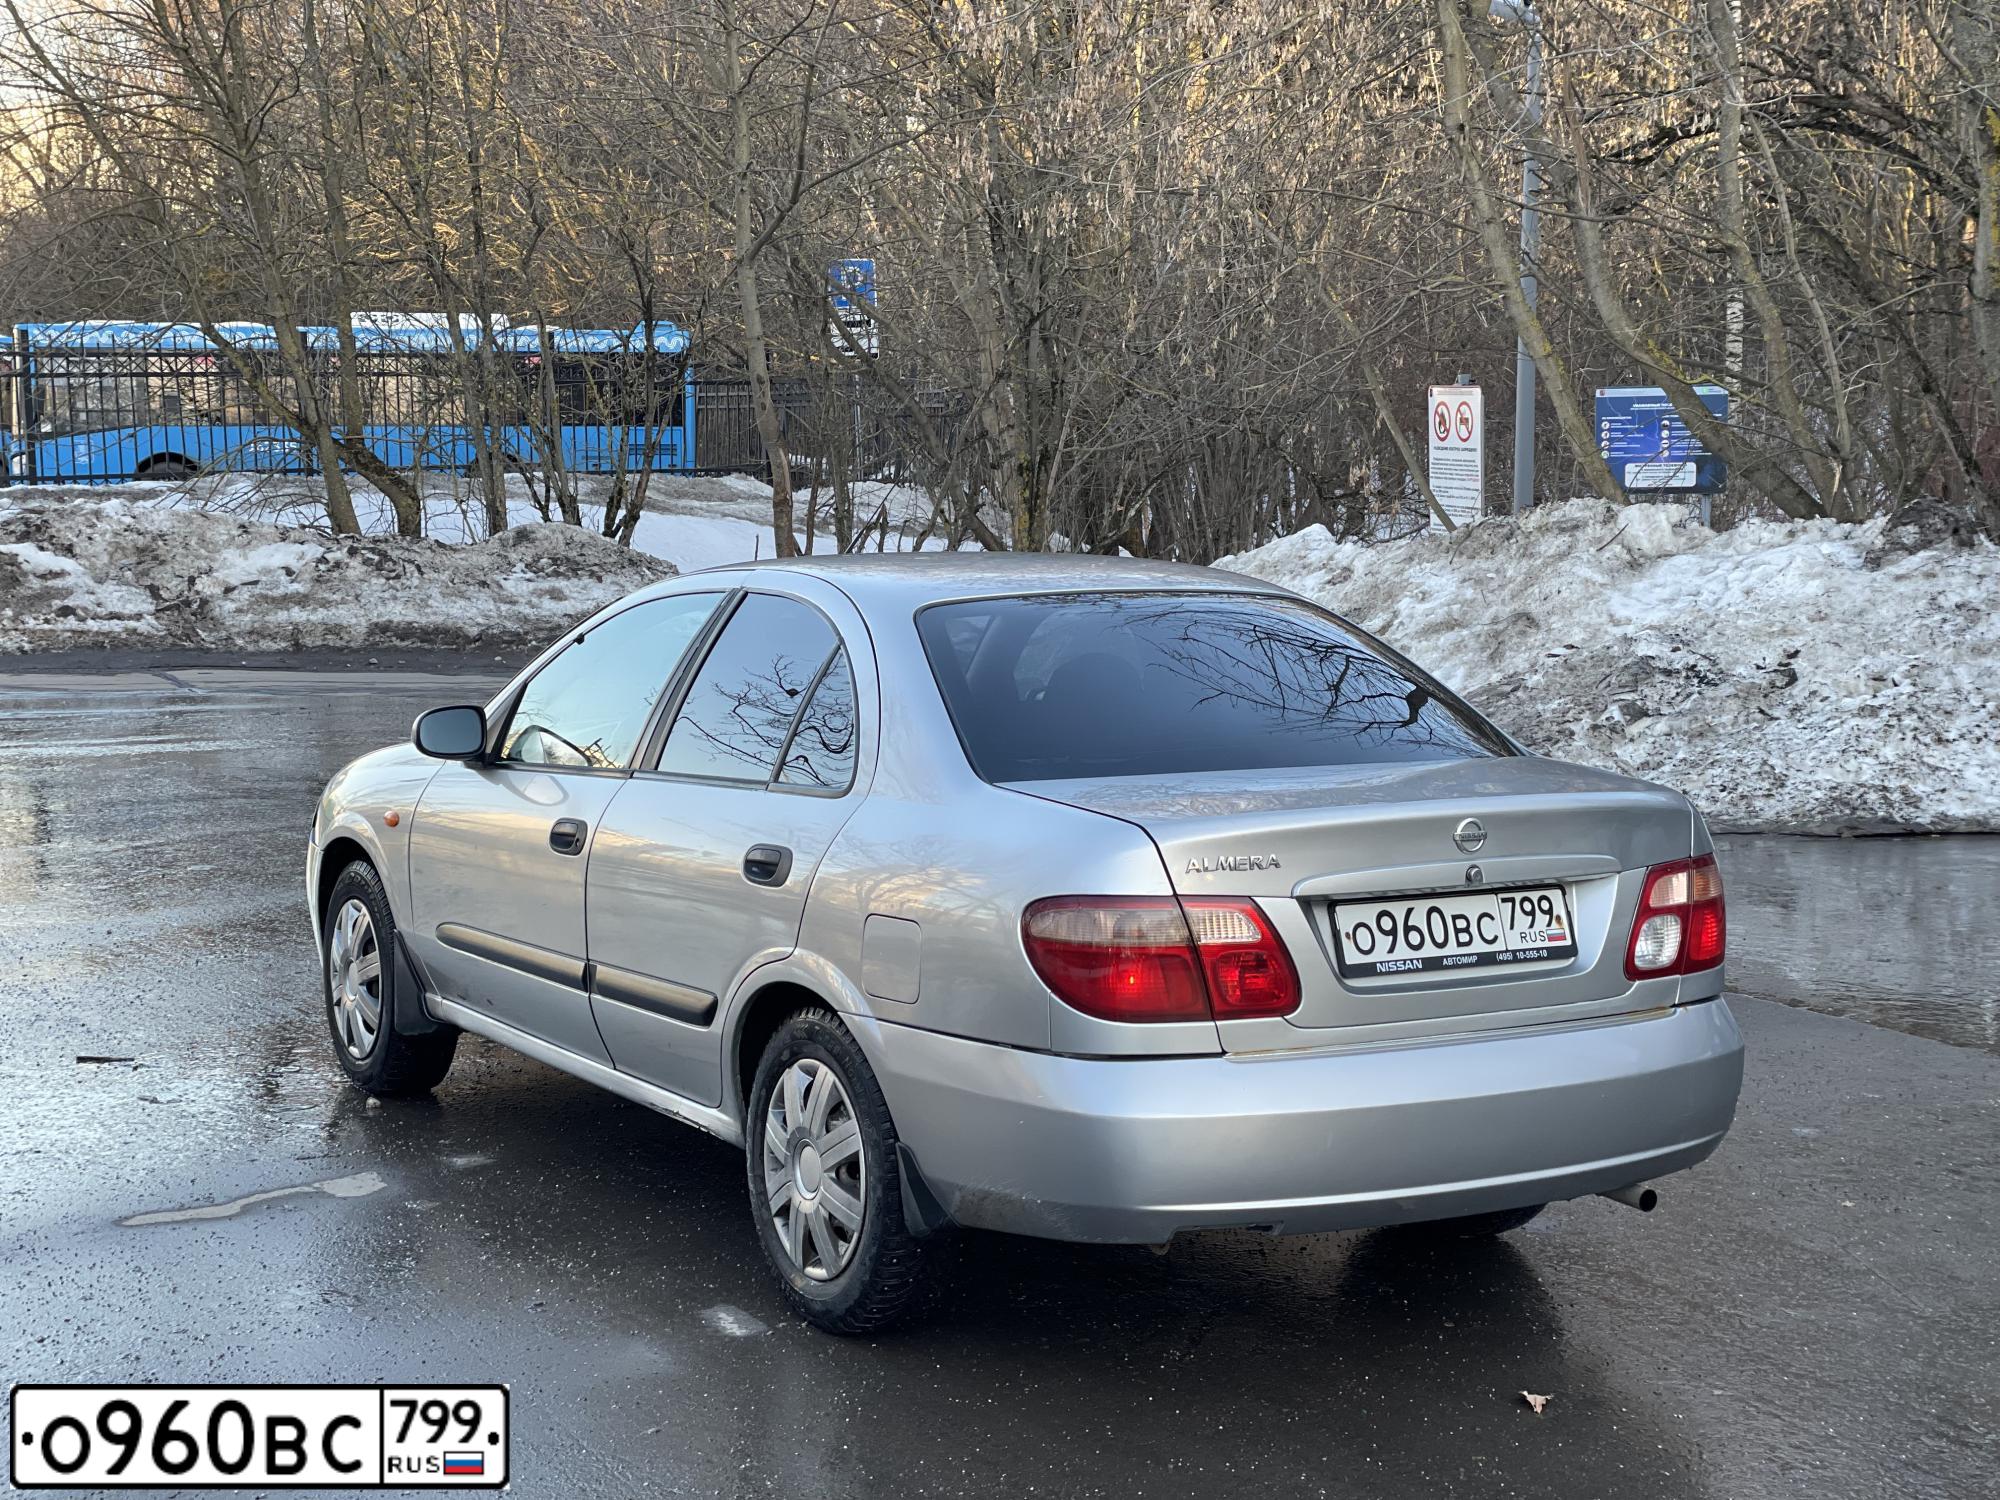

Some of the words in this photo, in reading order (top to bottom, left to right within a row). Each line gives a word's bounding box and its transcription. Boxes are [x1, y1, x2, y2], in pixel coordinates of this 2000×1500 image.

[1185, 853, 1282, 874] ALMERA
[1500, 894, 1555, 931] 799
[1519, 929, 1547, 944] RUS
[1442, 956, 1478, 966] АВТОМИР
[1496, 952, 1513, 962] (495)
[1376, 959, 1423, 973] NISSAN
